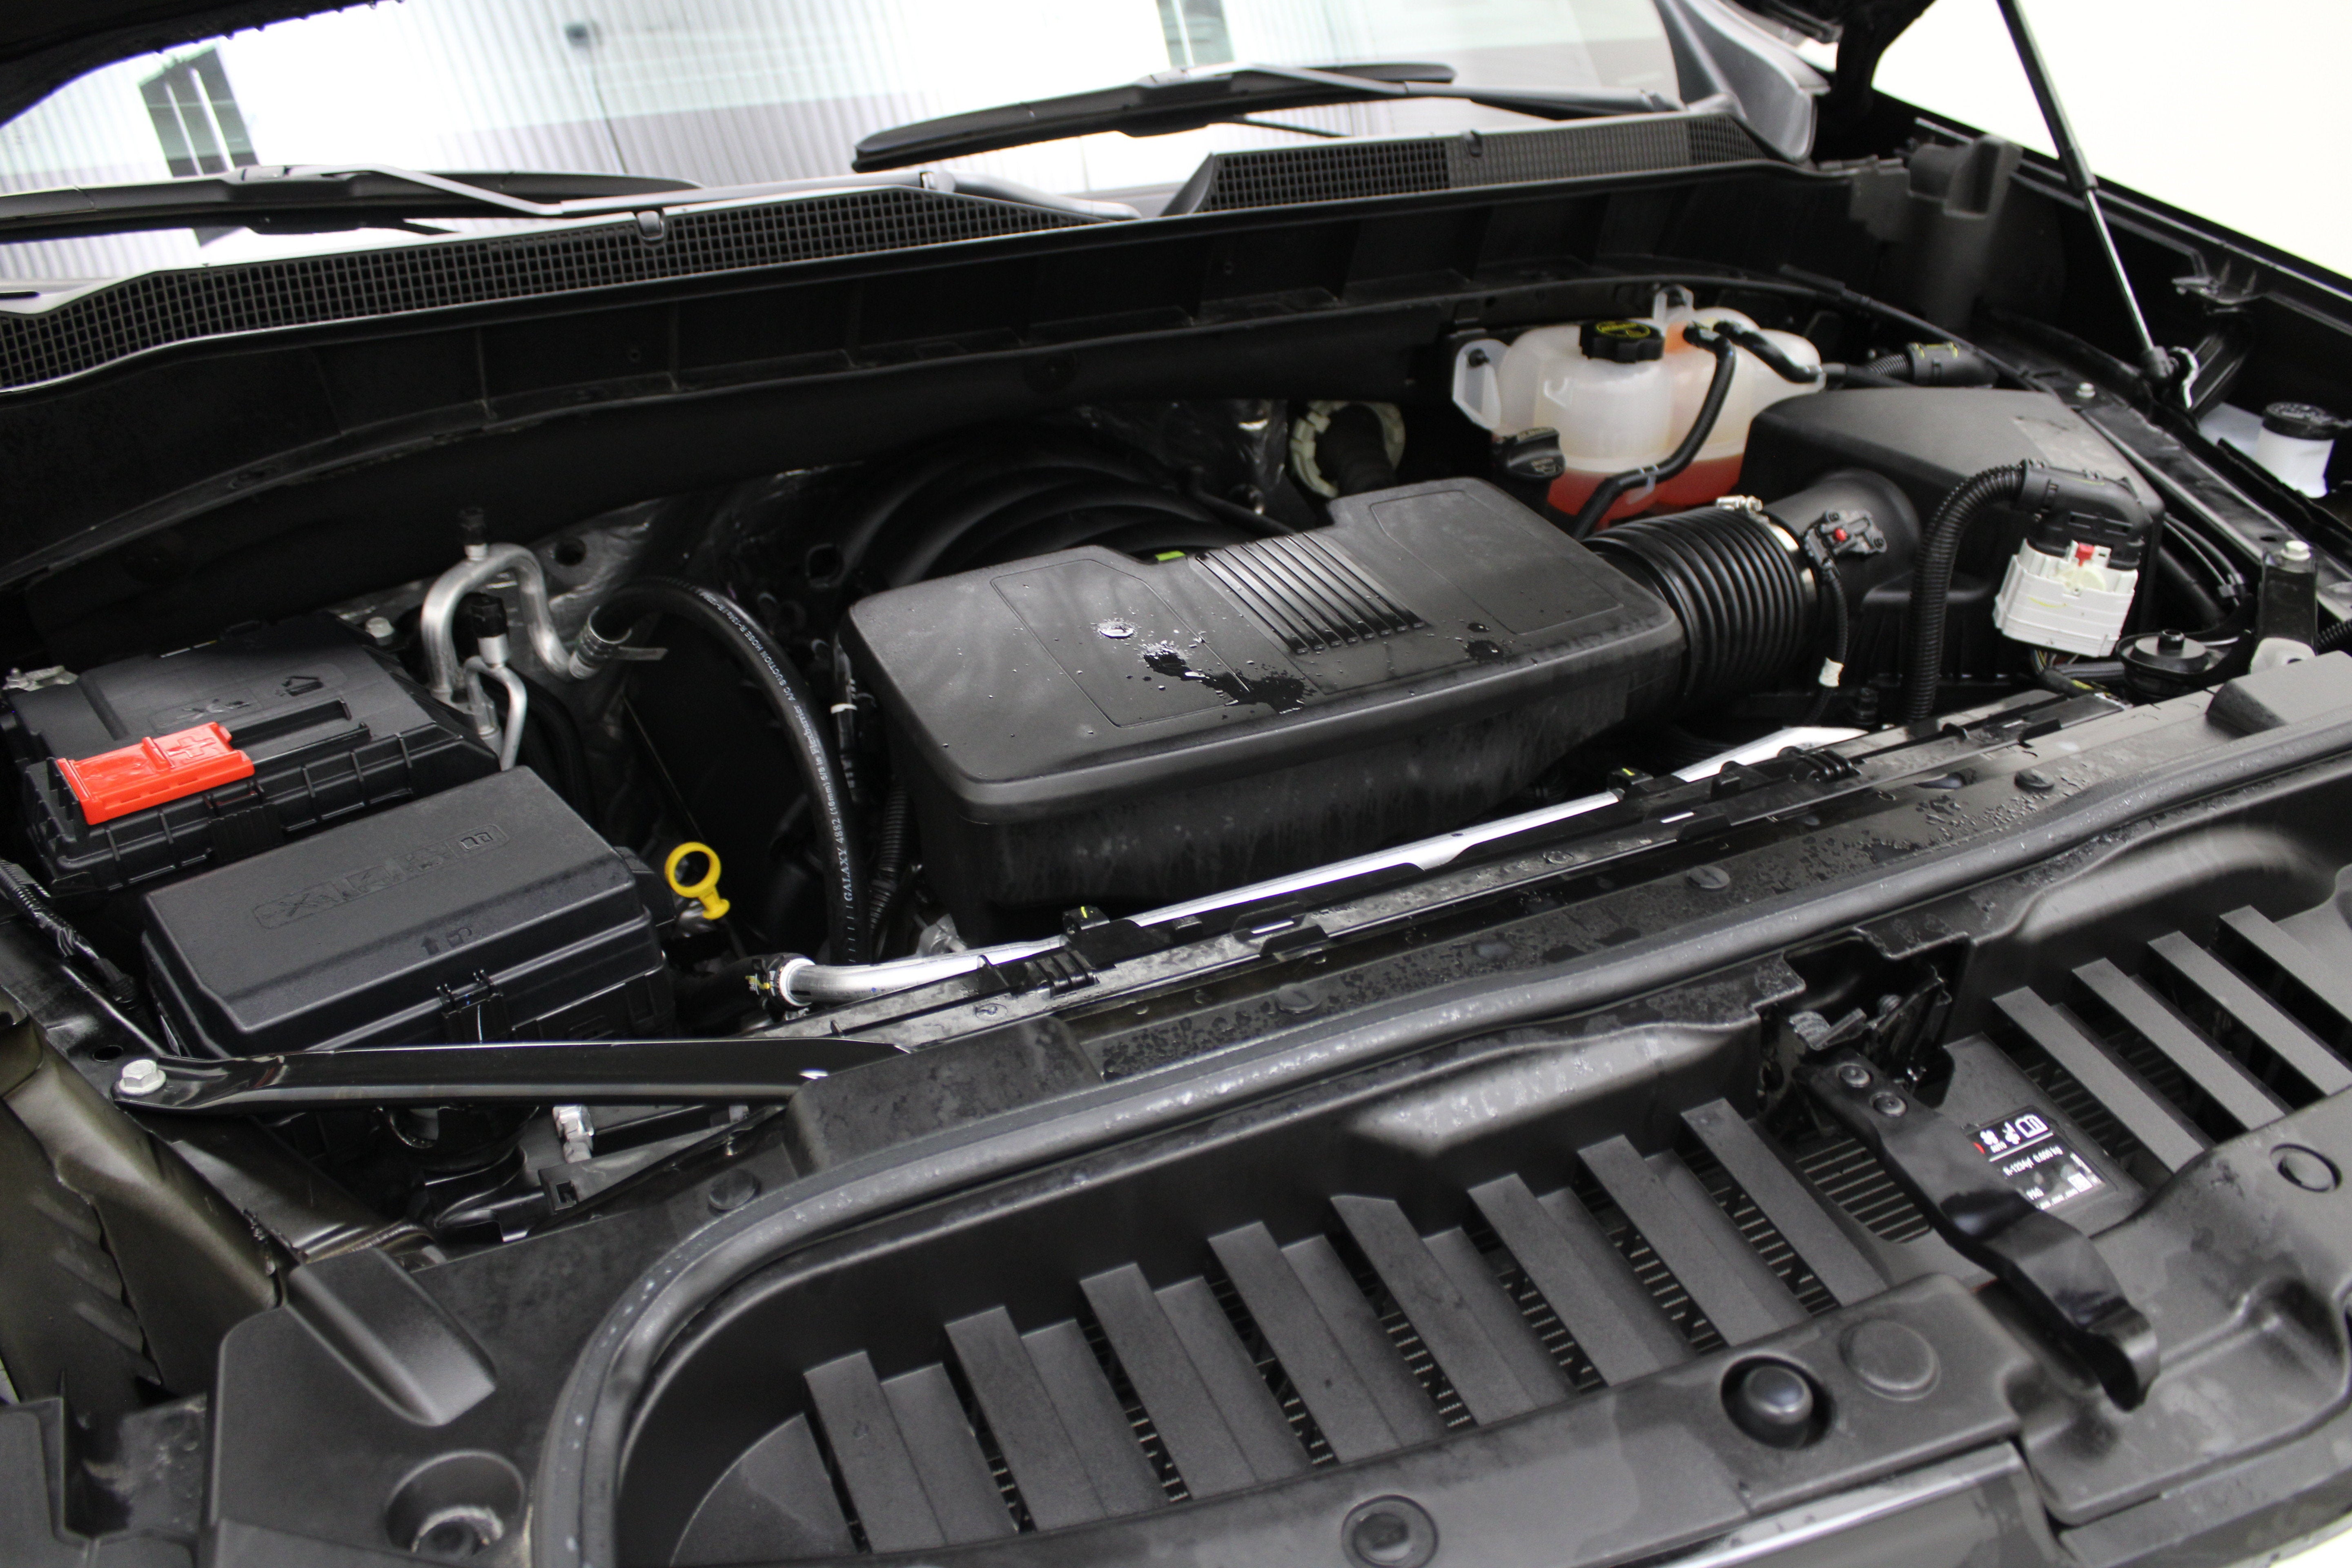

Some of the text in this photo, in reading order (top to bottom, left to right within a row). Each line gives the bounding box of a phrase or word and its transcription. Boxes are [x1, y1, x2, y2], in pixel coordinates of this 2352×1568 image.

[744, 630, 763, 651] HOSE
[760, 650, 787, 686] SUCTION
[783, 687, 796, 701] A/C
[818, 766, 828, 781] 5/8
[823, 782, 838, 815] (16mm)
[831, 818, 844, 844] 4882
[837, 847, 853, 901] GALAXY
[1990, 1140, 2008, 1154] AUTO
[2002, 1156, 2034, 1176] R-1234yf
[2050, 1145, 2063, 1156] kg
[2026, 1186, 2045, 1200] PAG
